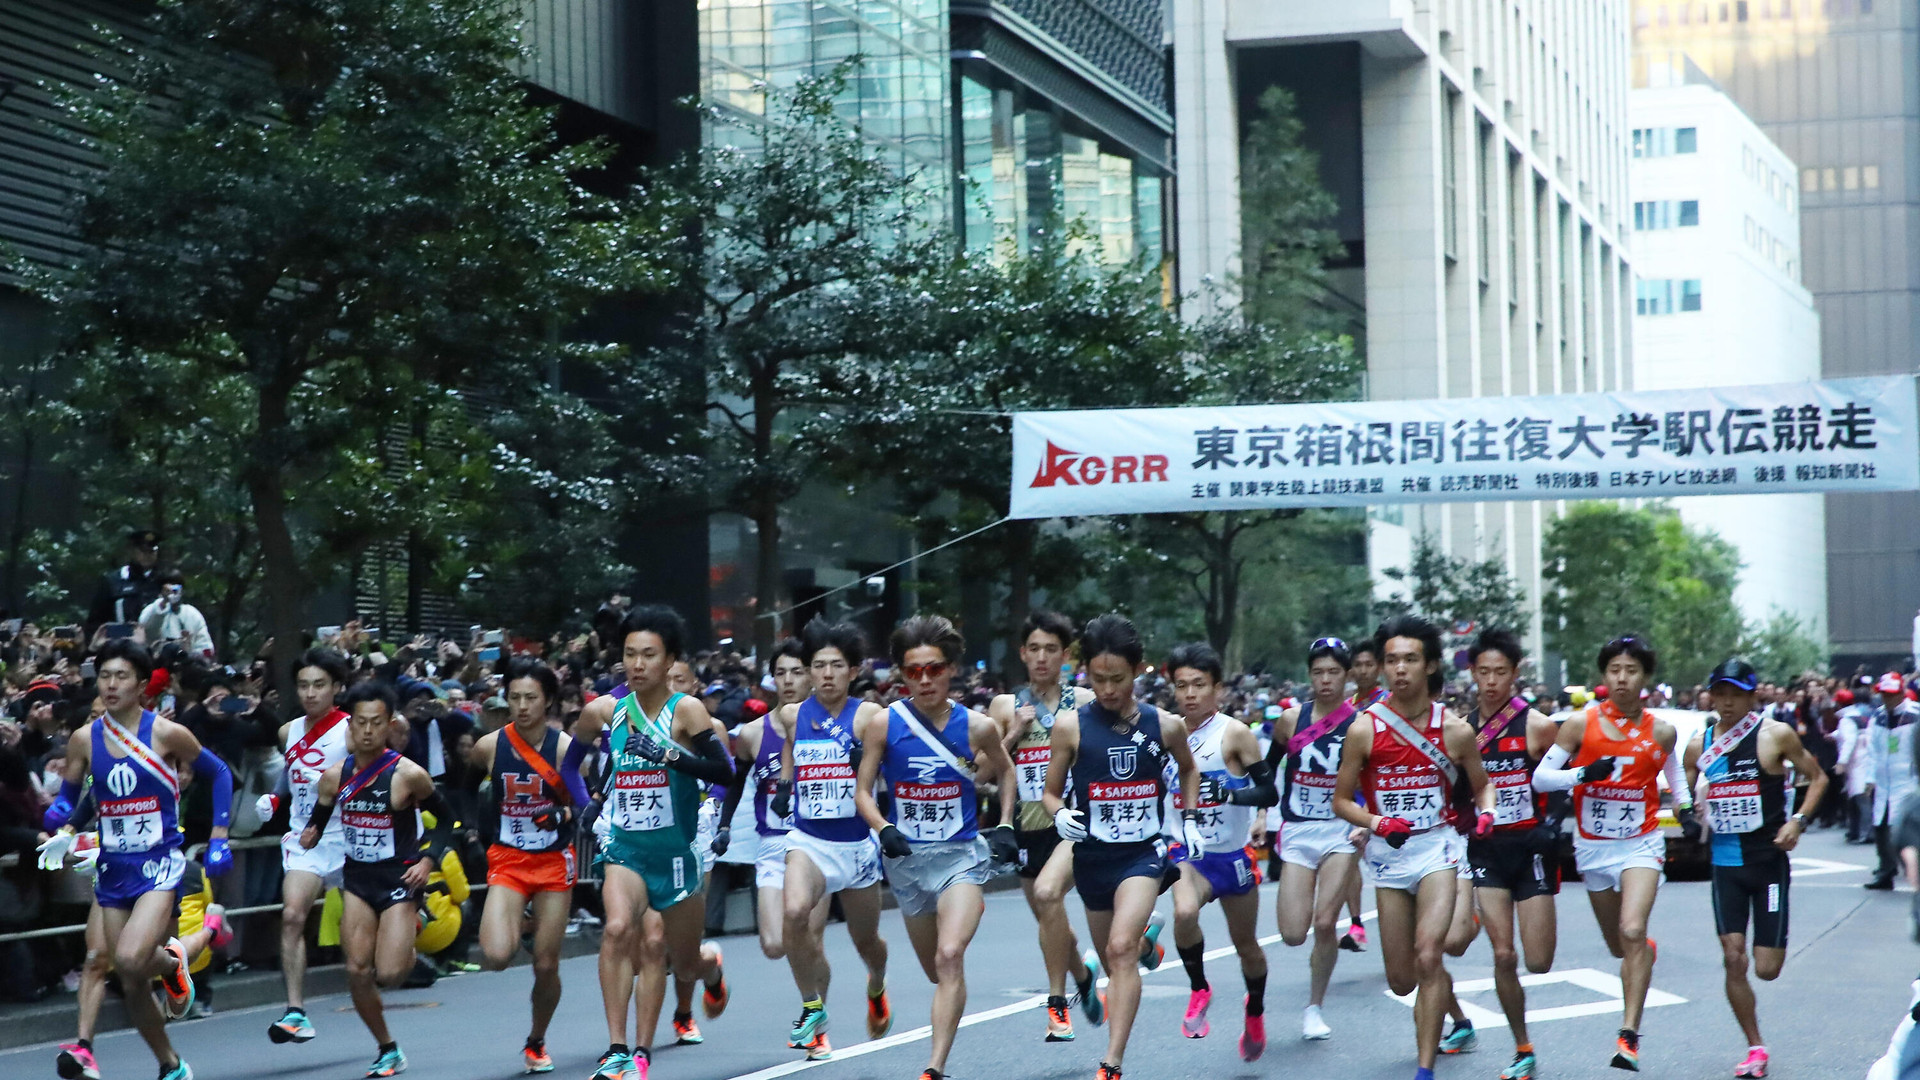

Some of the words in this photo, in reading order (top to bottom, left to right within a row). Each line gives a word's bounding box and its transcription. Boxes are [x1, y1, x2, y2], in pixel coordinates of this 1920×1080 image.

[1191, 402, 1878, 470] 東京箱根間往復大学駅伝競走
[1191, 482, 1221, 498] 主催
[1402, 476, 1431, 492] 共催
[807, 766, 853, 778] SAPPORO
[621, 774, 666, 787] SAPPORO
[1389, 775, 1439, 788] SAPPORO
[800, 781, 854, 801] 神奈川大
[909, 785, 959, 798] SAPPORO
[1105, 783, 1156, 798] SAPPORO
[1597, 787, 1644, 799] SAPPORO
[1714, 783, 1758, 797] SAPPORO
[110, 800, 157, 815] SAPPORO
[1382, 790, 1436, 812] 帝京大
[808, 803, 842, 817] 12-1
[902, 801, 955, 822] 東海大
[1098, 801, 1152, 823] 東洋大
[350, 815, 392, 828] SAPPORO
[622, 813, 661, 829] 2-12
[1716, 819, 1749, 832] 21-1
[914, 823, 945, 839] 1-1
[1110, 824, 1144, 840] 3-1
[118, 838, 150, 852] 8-1
